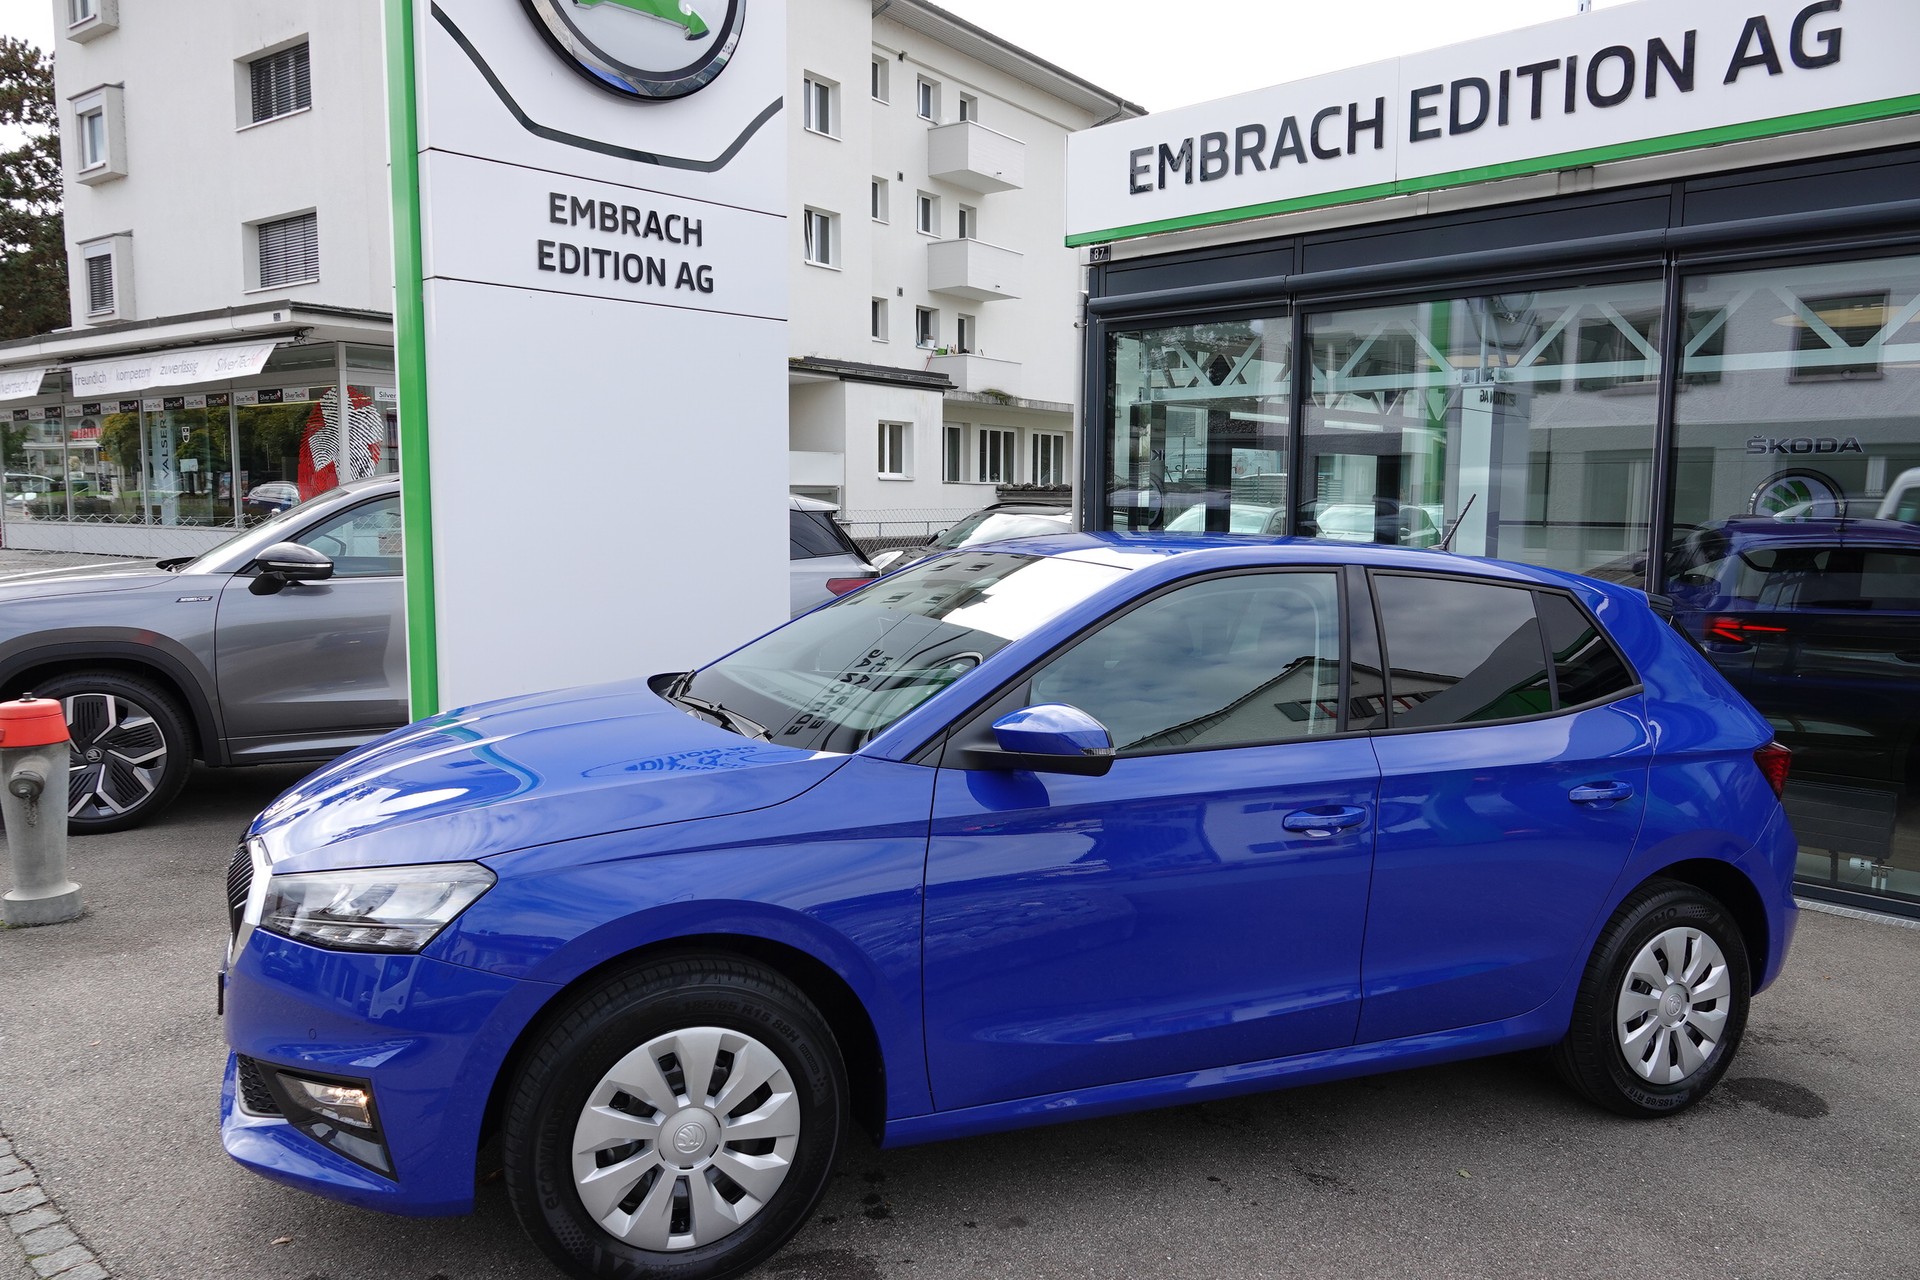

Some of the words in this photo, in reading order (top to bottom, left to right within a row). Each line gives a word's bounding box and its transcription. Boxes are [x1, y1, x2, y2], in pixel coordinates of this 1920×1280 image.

[1129, 97, 1385, 195] EMBRACH
[1409, 29, 1697, 143] EDITION
[1723, 0, 1843, 85] AG
[549, 191, 703, 247] EMBRACH
[537, 239, 666, 287] EDITION
[675, 261, 714, 294] AG
[1094, 248, 1105, 260] 87
[74, 371, 107, 386] freundlich
[115, 368, 151, 384] kompetent
[160, 359, 199, 376] zuverlässig
[1746, 435, 1864, 455] ŠKODA
